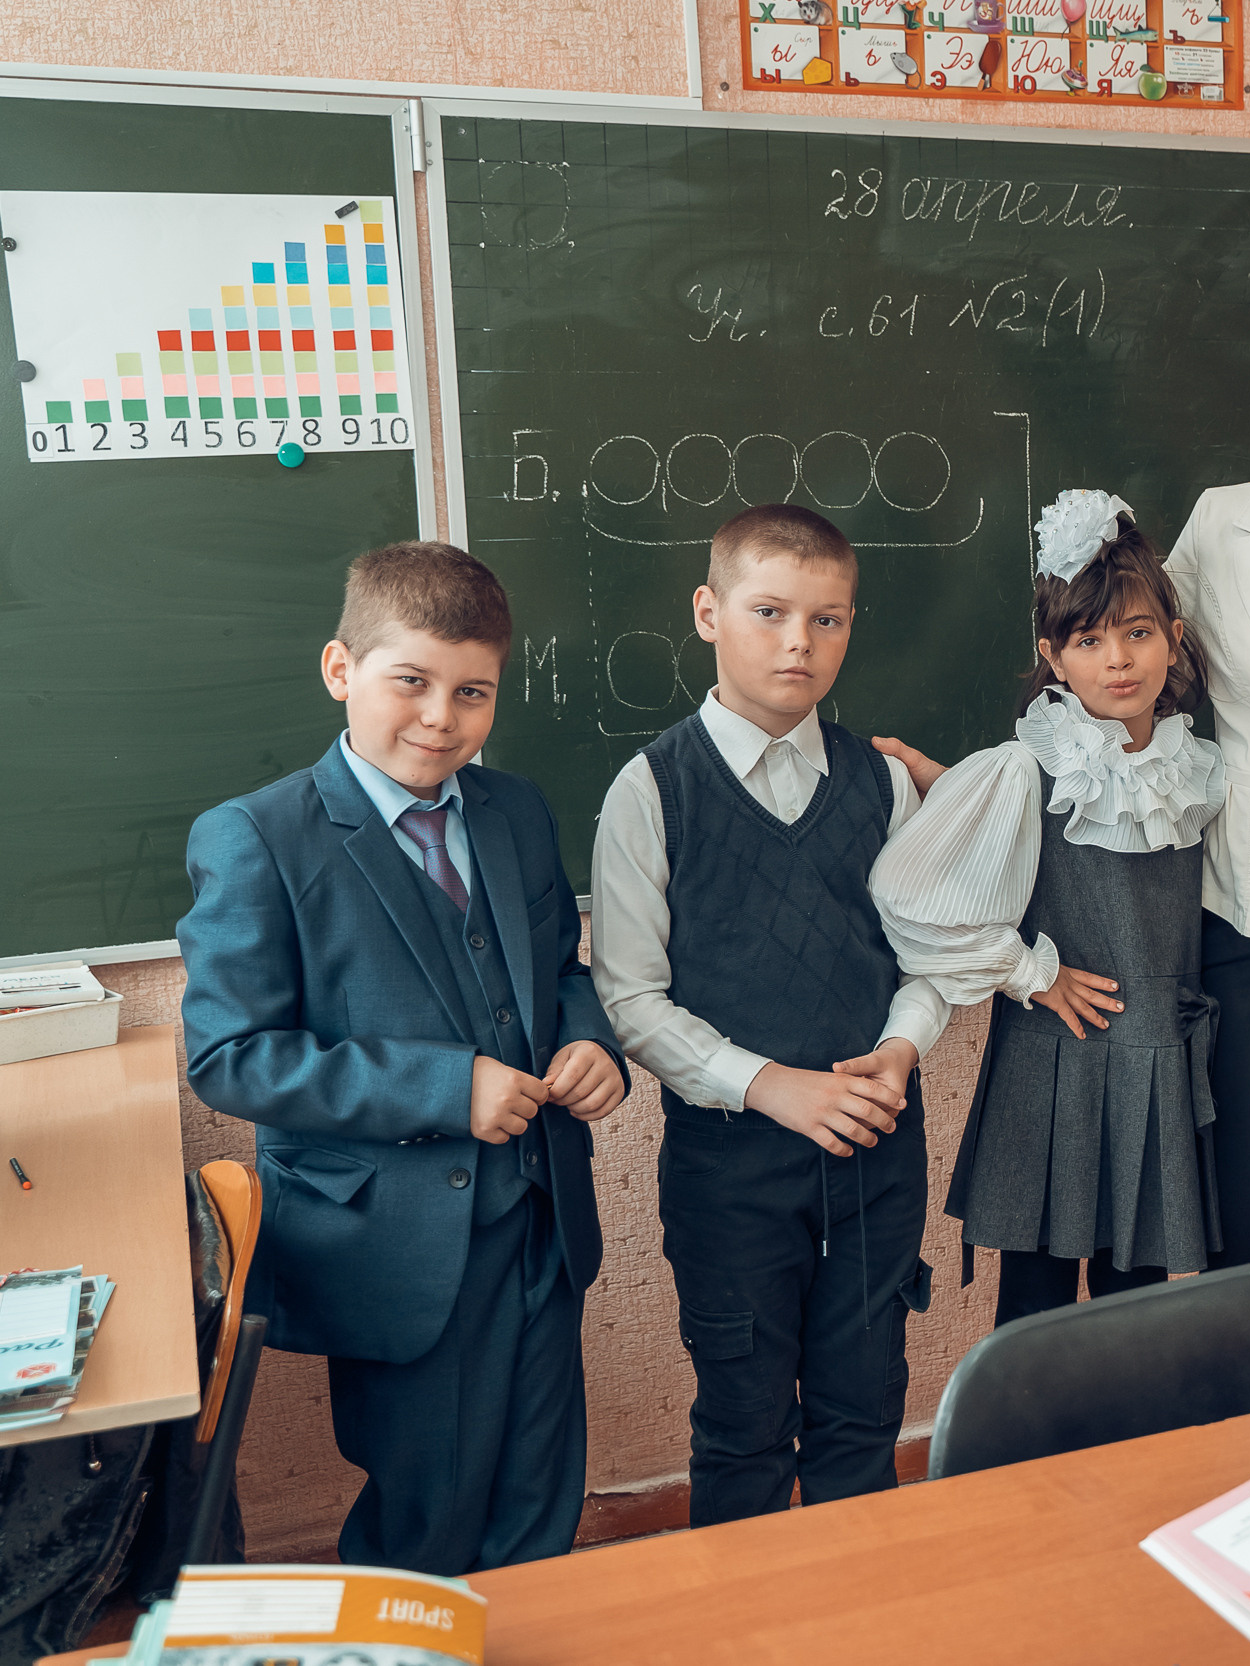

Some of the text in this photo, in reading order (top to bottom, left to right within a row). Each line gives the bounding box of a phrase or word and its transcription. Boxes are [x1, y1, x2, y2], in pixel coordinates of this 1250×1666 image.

[842, 5, 861, 31] Ц
[928, 11, 944, 32] Ч
[1011, 16, 1035, 36] Ш
[1088, 19, 1109, 43] Щ
[940, 35, 975, 71] Ээ
[1011, 39, 1066, 75] Юю
[1098, 44, 1140, 79] Яя
[930, 70, 947, 90] Э
[1013, 74, 1037, 95] Ю
[1097, 78, 1113, 98] Я
[824, 167, 1134, 242] 28 апреля.
[31, 417, 410, 453] 0 1 2 3 4 5 6 7 8 9 10
[376, 1596, 456, 1632] SPORT
